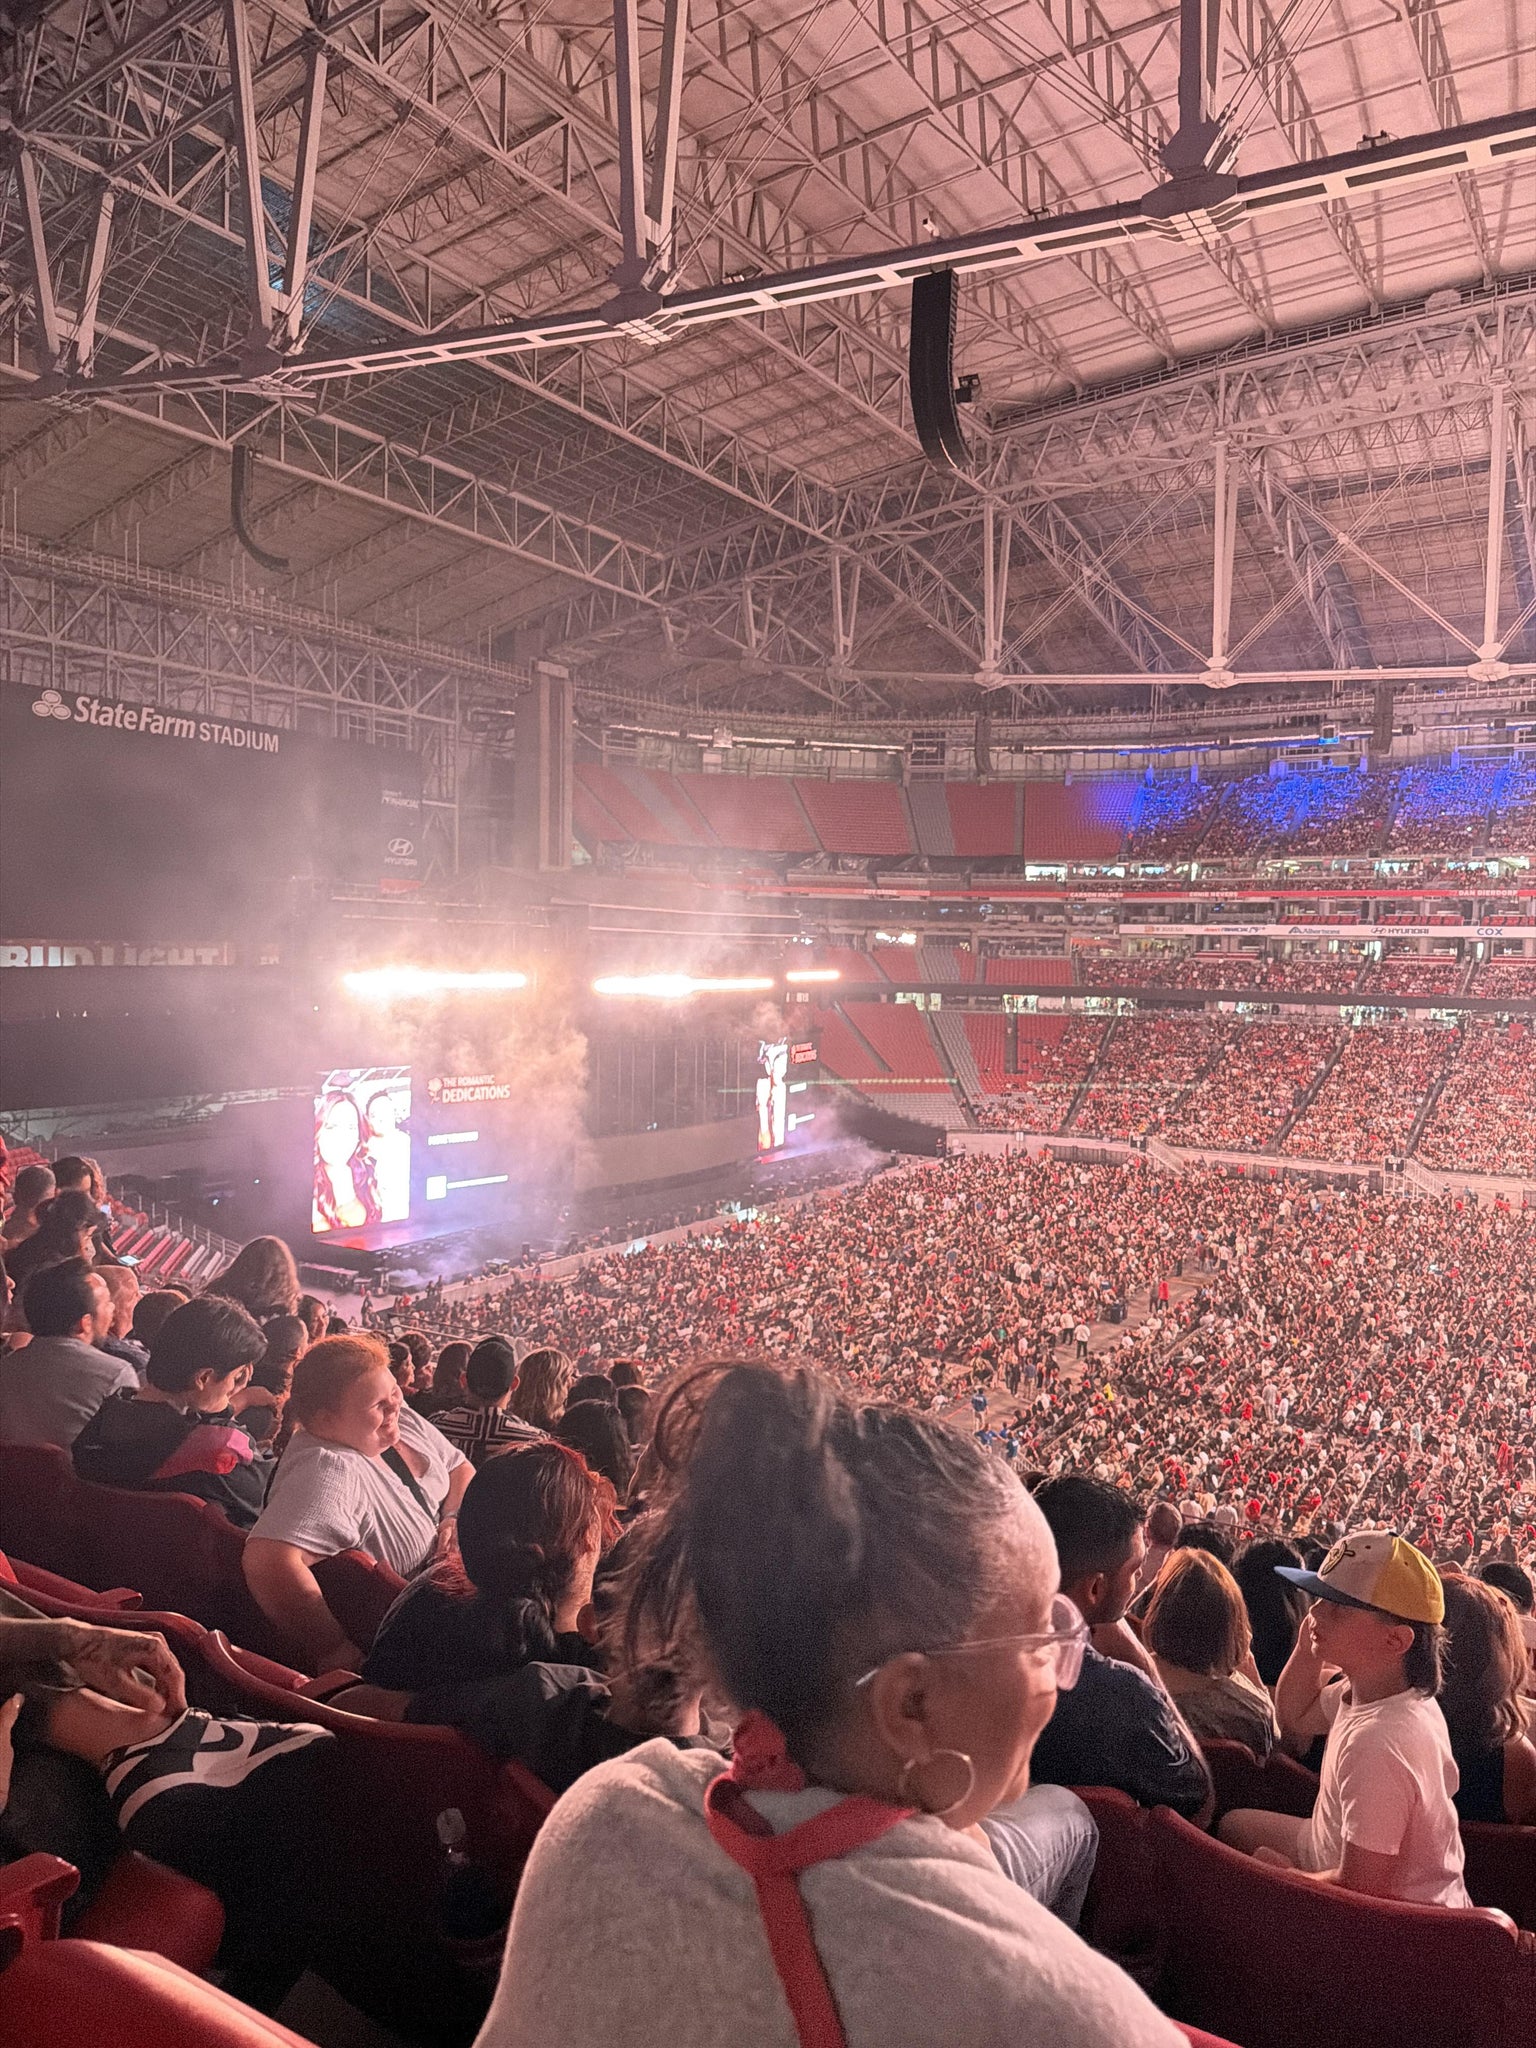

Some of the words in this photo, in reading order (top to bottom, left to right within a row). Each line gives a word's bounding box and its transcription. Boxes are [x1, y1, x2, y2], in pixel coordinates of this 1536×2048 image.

[200, 722, 279, 753] STADIUM
[1476, 927, 1503, 936] COX
[443, 1077, 457, 1088] THE
[442, 1083, 511, 1104] DEDICATIONS
